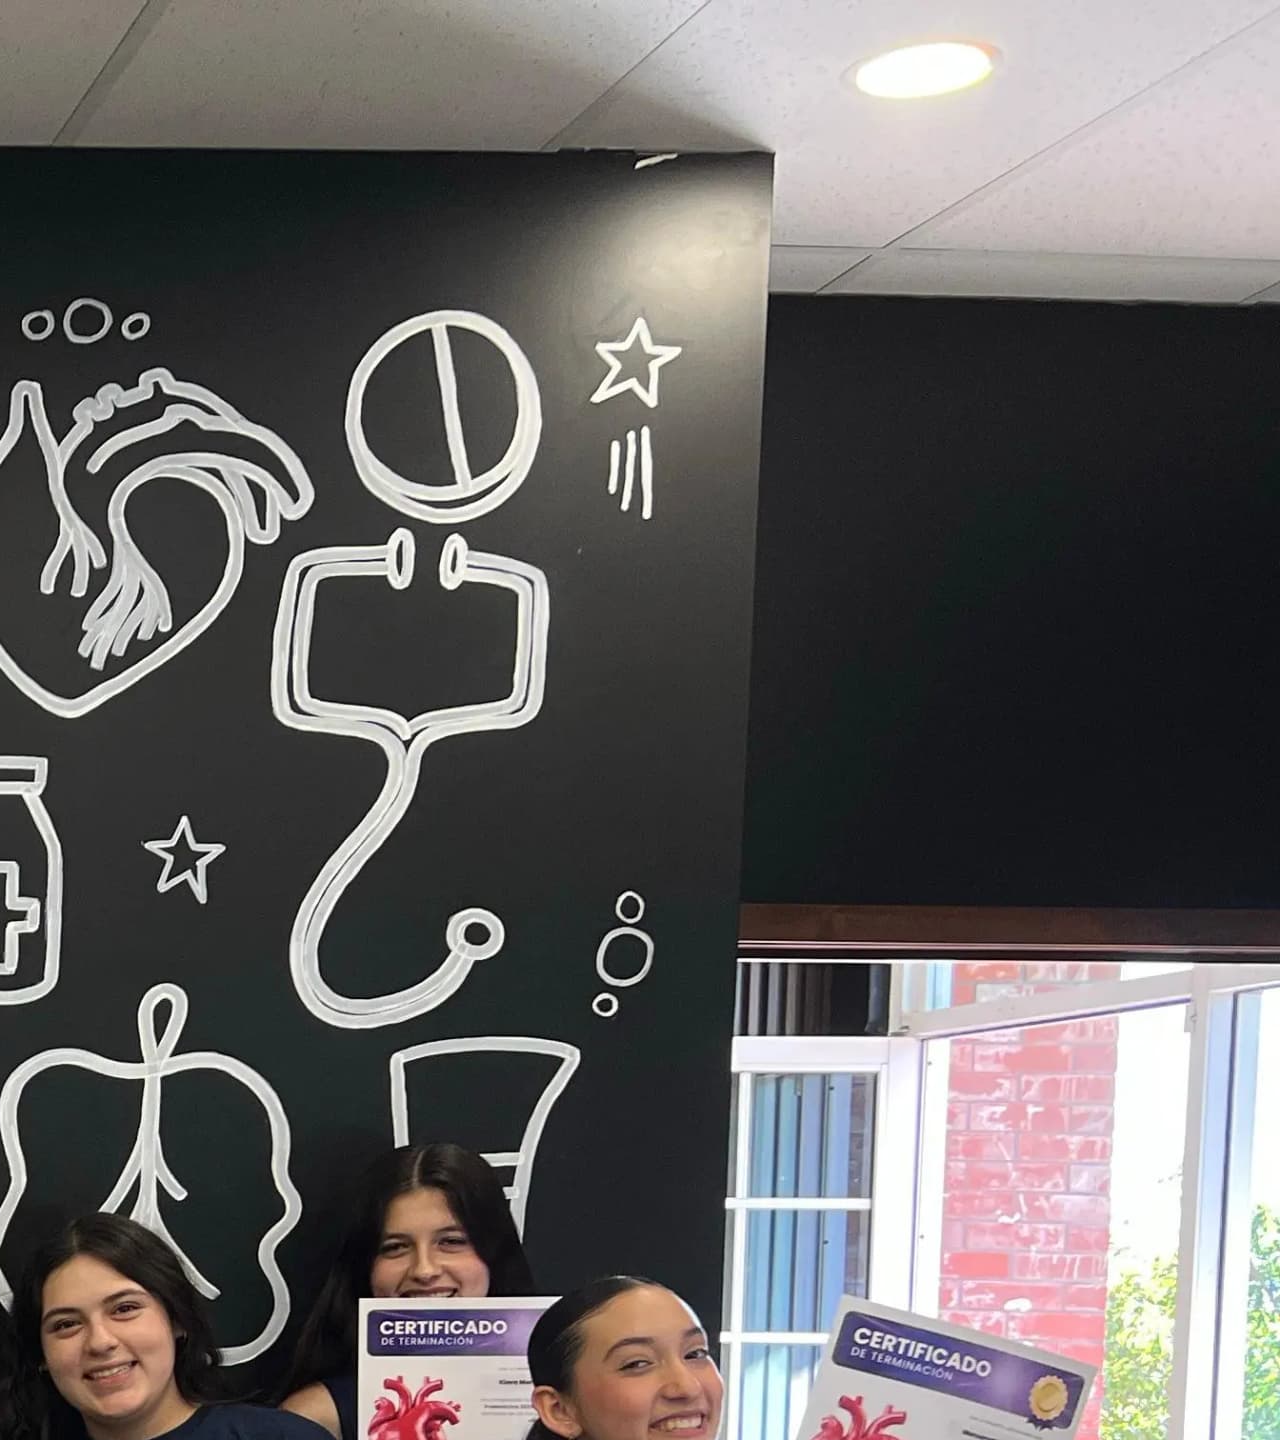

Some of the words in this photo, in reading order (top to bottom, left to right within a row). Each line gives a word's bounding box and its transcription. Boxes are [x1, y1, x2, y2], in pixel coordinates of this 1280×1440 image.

[379, 1320, 507, 1335] CERTIFICADO
[381, 1337, 394, 1346] DE
[399, 1336, 473, 1346] TERMINACIÓN
[853, 1327, 991, 1378] CERTIFICADO
[850, 1347, 865, 1358] DE
[870, 1351, 953, 1381] TERMINACIÓN
